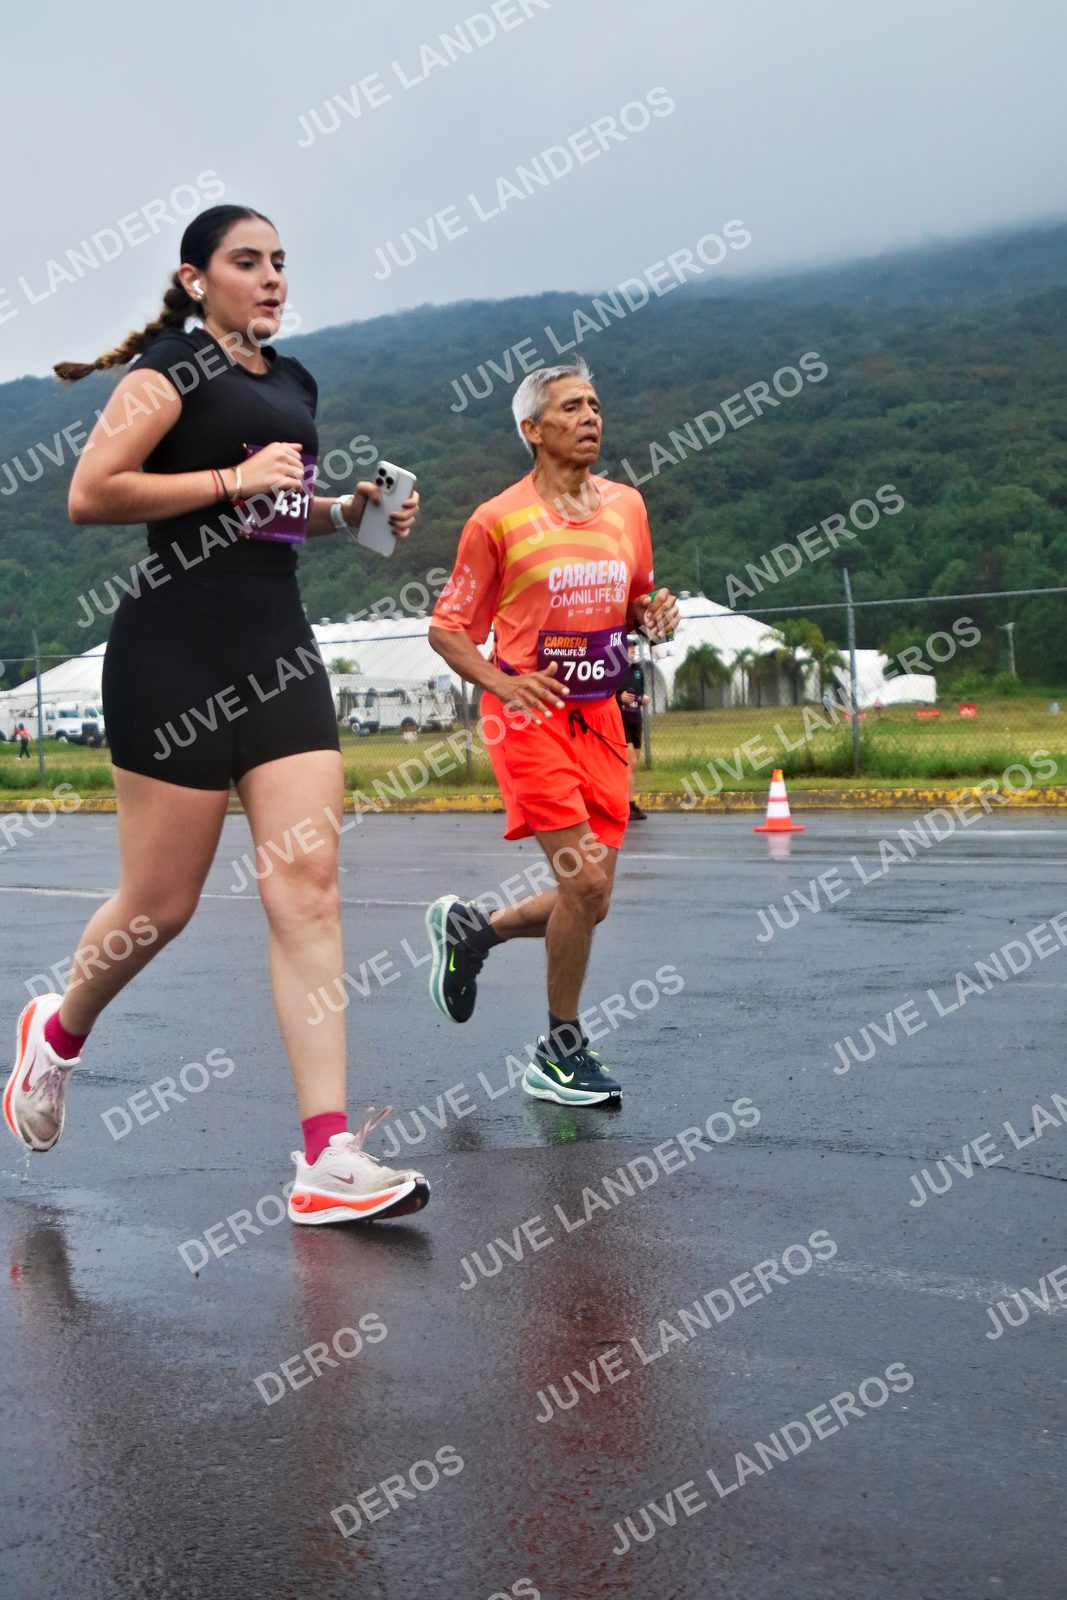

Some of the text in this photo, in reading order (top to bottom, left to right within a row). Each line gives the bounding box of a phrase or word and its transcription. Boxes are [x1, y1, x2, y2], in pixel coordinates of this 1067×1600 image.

[274, 490, 310, 520] 431
[548, 560, 627, 592] CARRERA
[550, 587, 612, 608] OMNILIFE
[544, 636, 588, 648] CARRERA
[610, 632, 623, 647] 15K
[562, 659, 606, 682] 706
